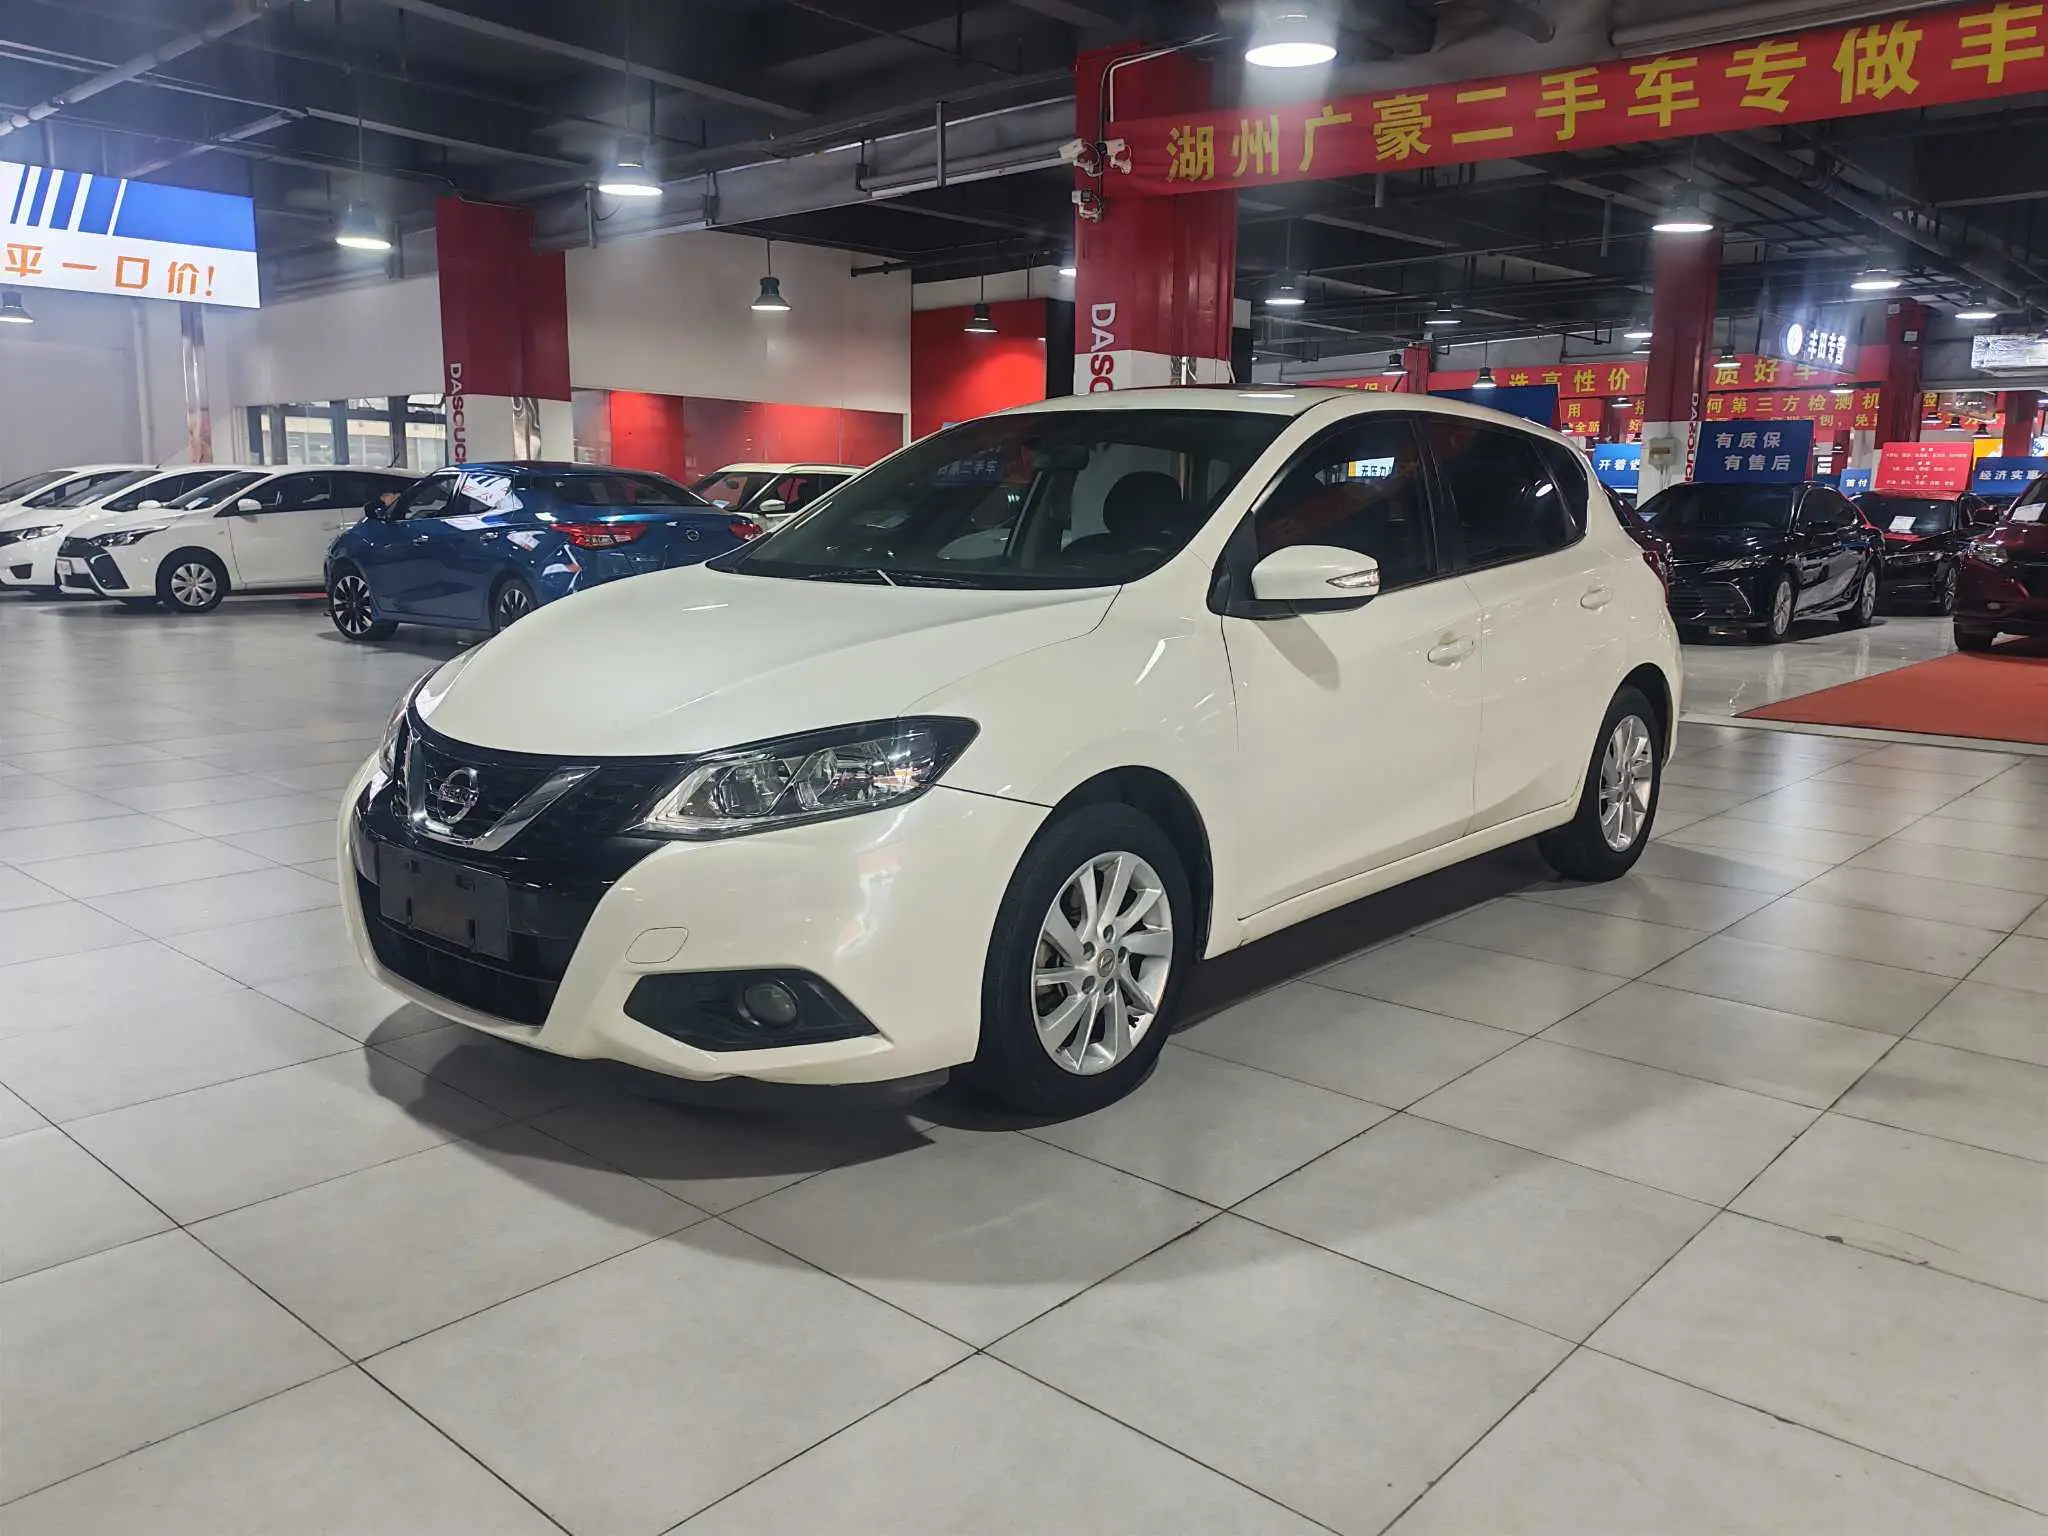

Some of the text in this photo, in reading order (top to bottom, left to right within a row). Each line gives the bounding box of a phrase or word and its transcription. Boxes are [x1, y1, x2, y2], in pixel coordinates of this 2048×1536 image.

[1166, 3, 2046, 183] 湖州广豪二手车专做丰
[1685, 392, 1699, 481] DASOUC
[1715, 431, 1782, 449] 有质保
[1724, 454, 1791, 471] 有售后
